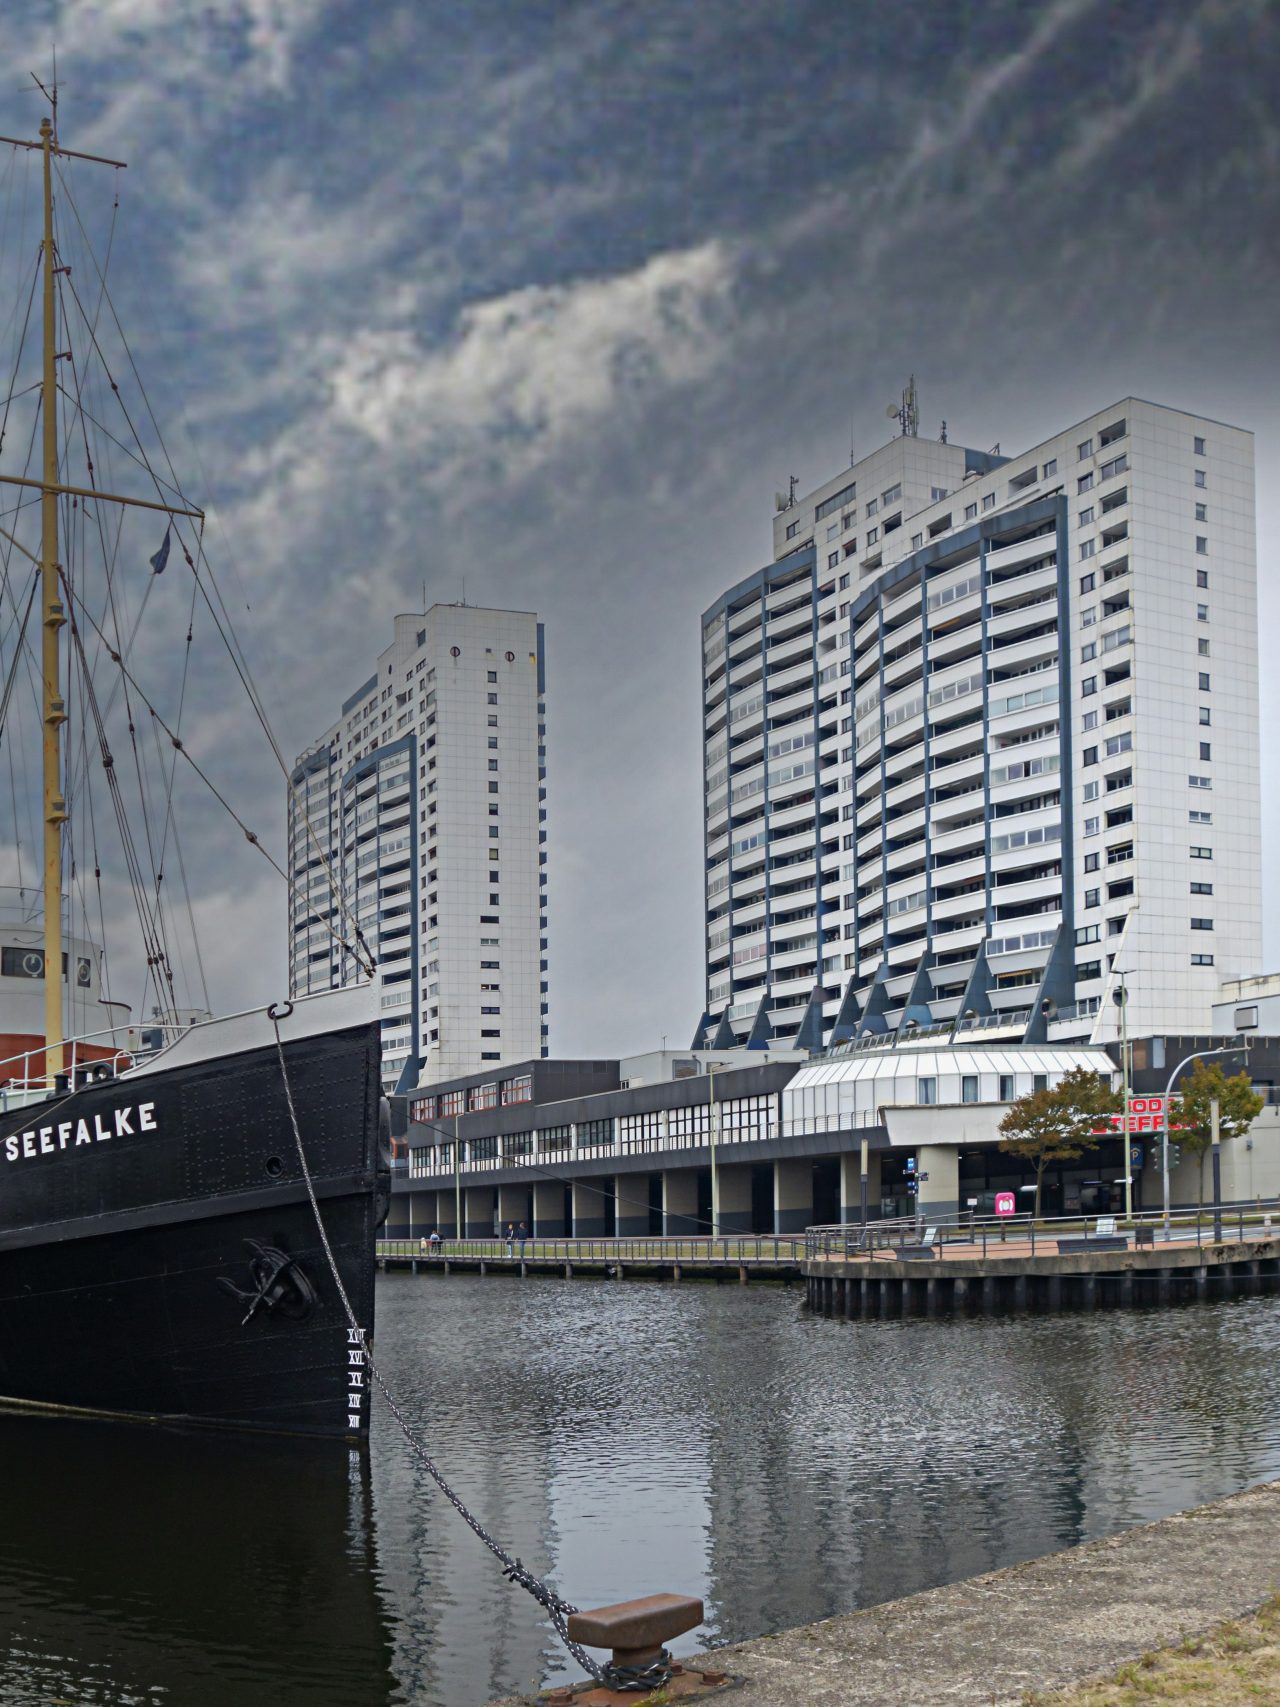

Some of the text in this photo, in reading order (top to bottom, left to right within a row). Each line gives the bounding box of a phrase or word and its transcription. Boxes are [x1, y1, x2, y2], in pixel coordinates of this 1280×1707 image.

[1116, 1098, 1177, 1114] OD
[5, 1102, 158, 1162] SEEFALKE
[347, 1350, 365, 1365] XVI
[347, 1371, 364, 1387] XV
[348, 1393, 362, 1408] XIV
[347, 1414, 361, 1428] XIII
